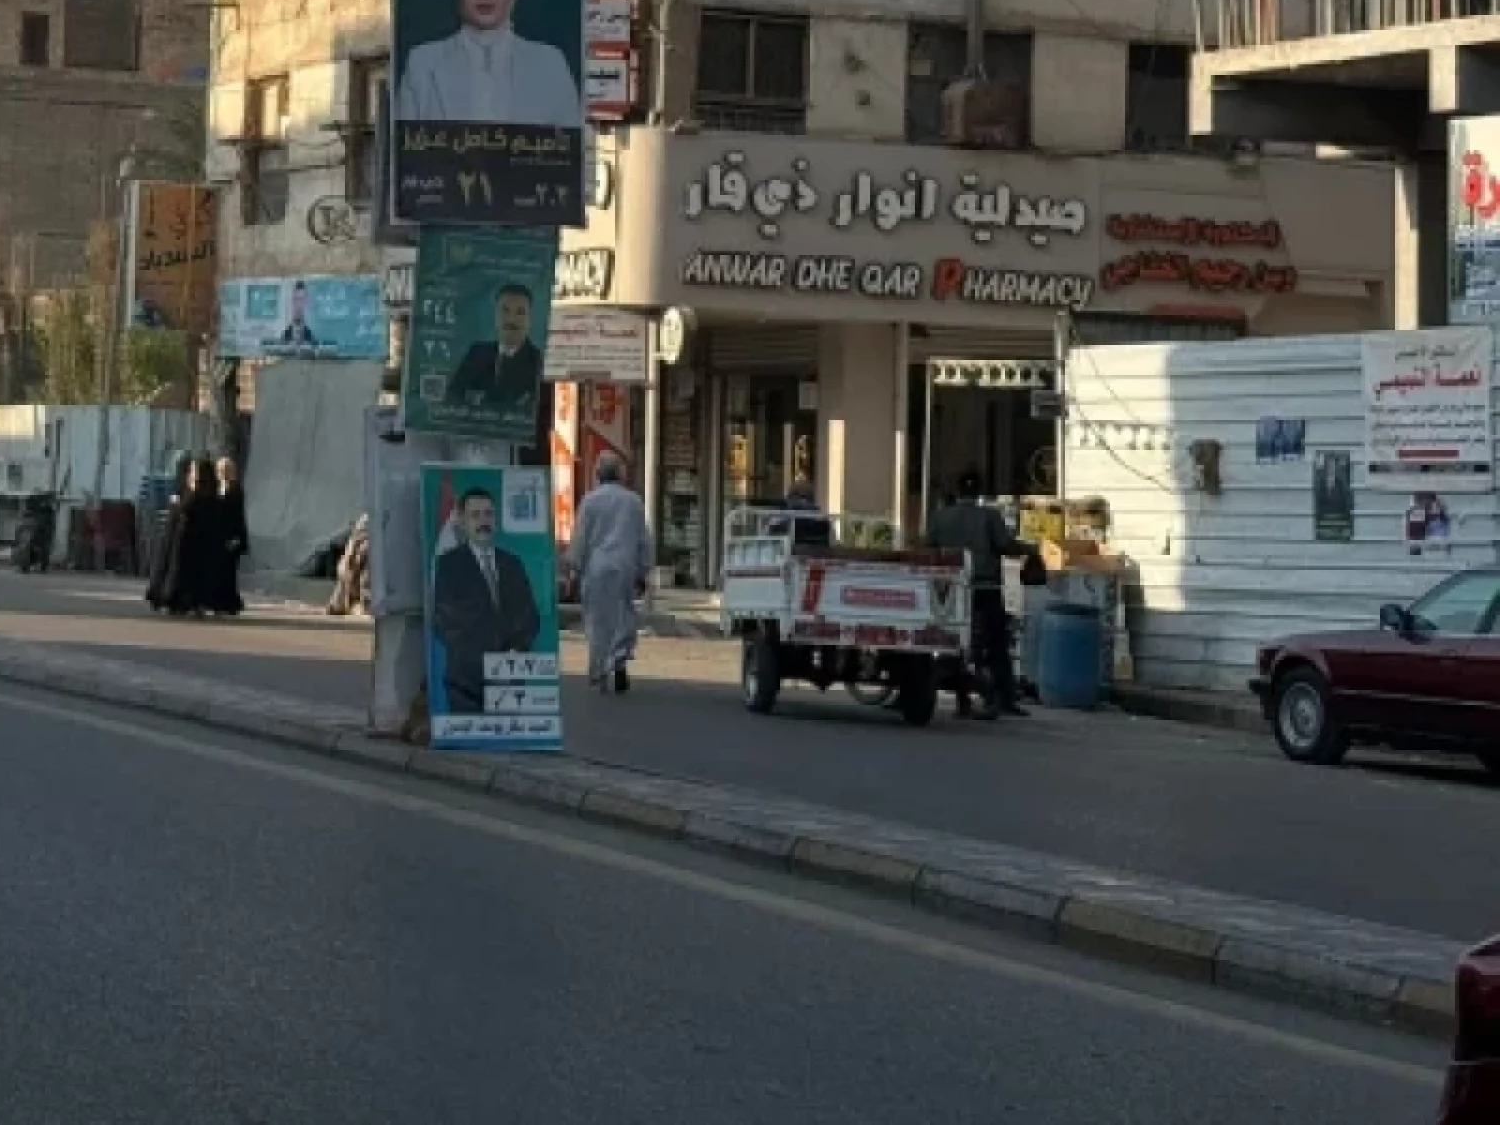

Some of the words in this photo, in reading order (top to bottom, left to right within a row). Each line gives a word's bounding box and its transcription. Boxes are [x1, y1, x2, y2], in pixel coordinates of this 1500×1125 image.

[684, 150, 747, 218] قار
[752, 157, 819, 237] ذي
[950, 172, 1087, 244] صيدلية
[683, 249, 786, 287] ANWAR
[860, 263, 921, 297] QAR
